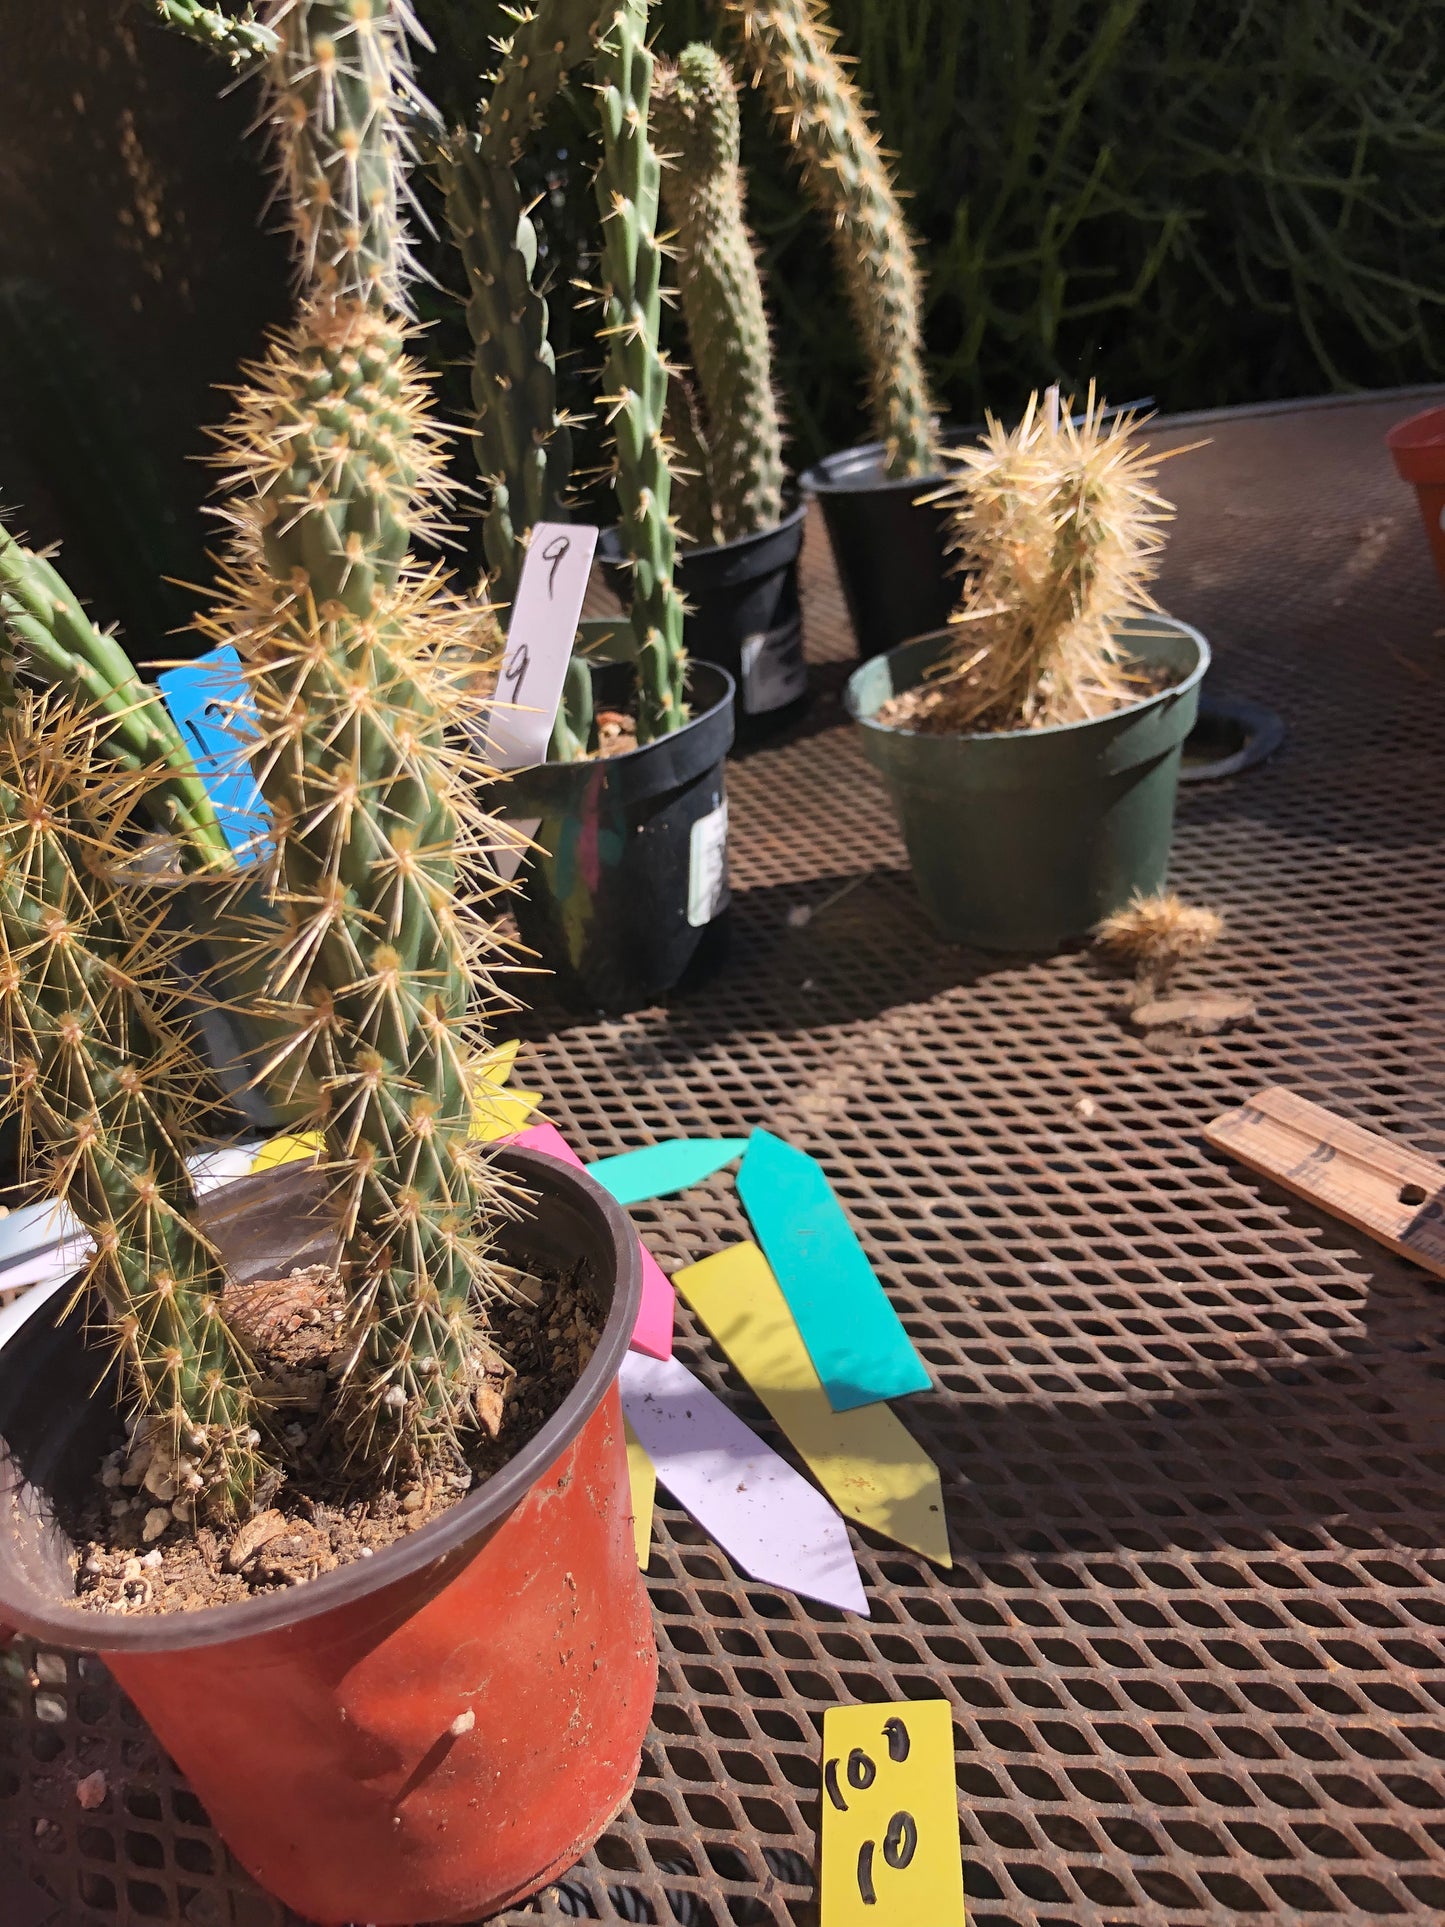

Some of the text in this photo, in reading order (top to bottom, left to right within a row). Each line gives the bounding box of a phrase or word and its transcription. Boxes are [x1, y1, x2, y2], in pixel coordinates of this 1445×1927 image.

[542, 535, 570, 601] 9
[505, 643, 531, 710] 9
[856, 1810, 918, 1905] 10
